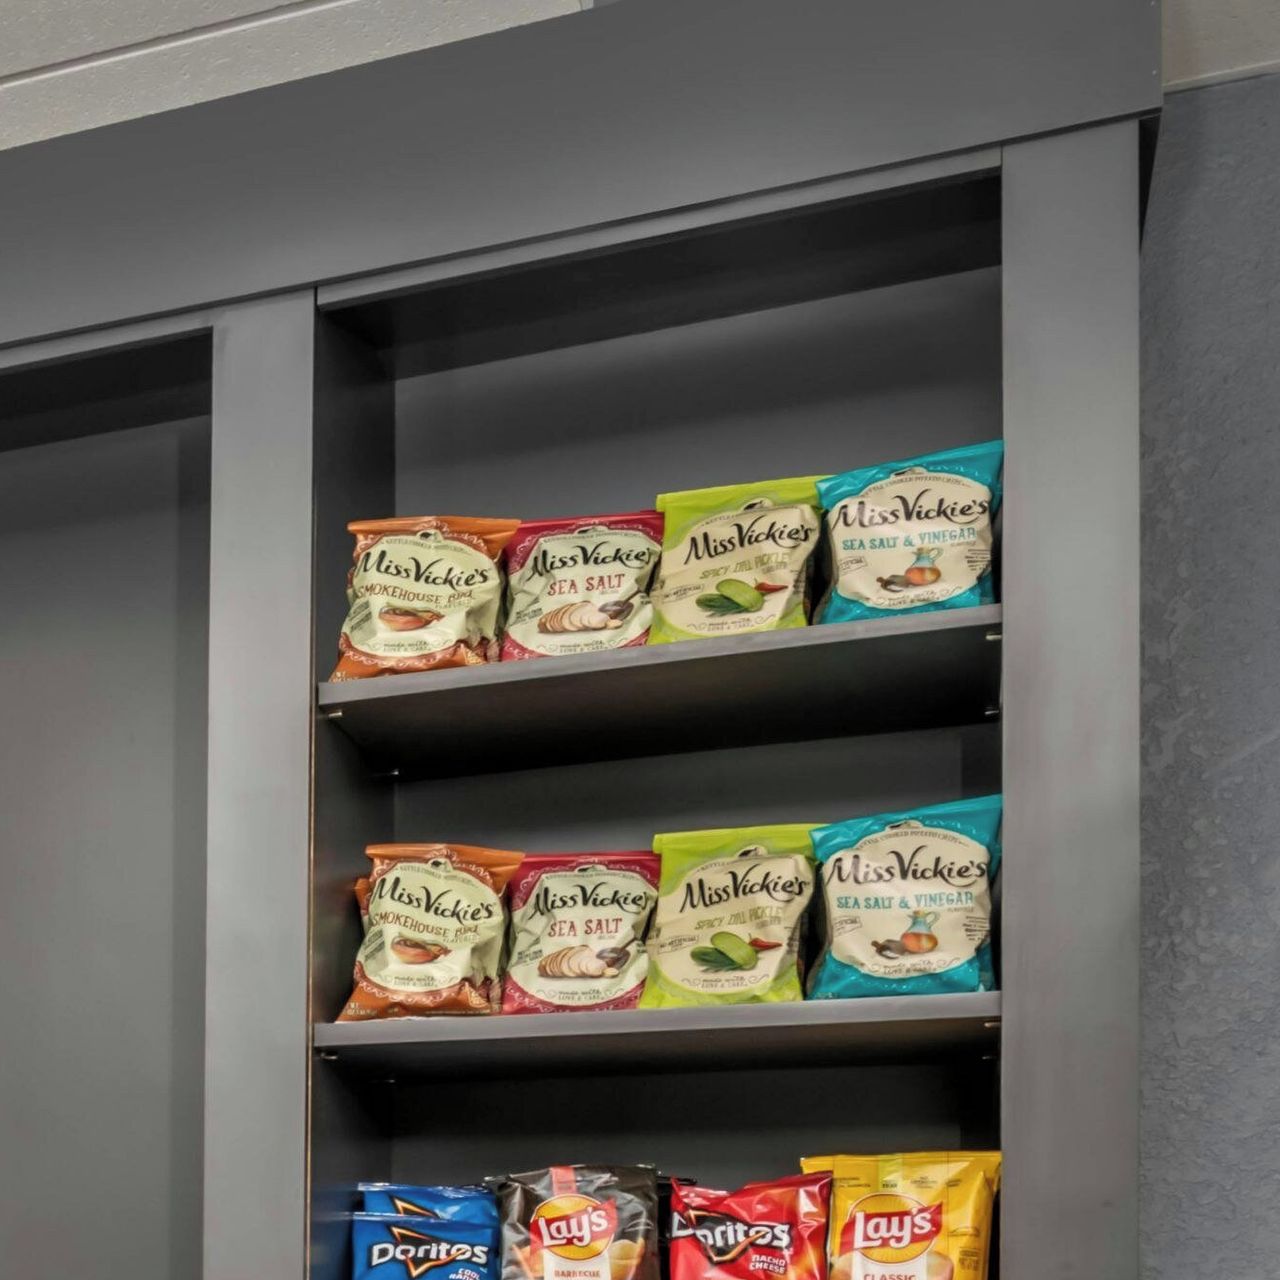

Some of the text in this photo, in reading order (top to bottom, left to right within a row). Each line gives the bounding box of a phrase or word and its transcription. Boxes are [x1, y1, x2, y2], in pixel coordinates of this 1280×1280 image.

[832, 488, 989, 531] Miss Vickie's
[683, 514, 814, 565] Miss Vickie's
[842, 527, 977, 551] SEA SALT & VINEGAR
[355, 550, 490, 591] Miss Vickie's
[526, 549, 578, 582] Miss
[356, 583, 441, 604] SMOKEHOUSE
[548, 573, 625, 597] SEA SALT
[826, 845, 987, 888] Miss Vickie's
[372, 877, 495, 923] Miss Vickie's
[528, 887, 578, 920] Miss
[679, 864, 807, 913] Miss Vickie's
[837, 891, 975, 909] SEA SALT & VINEGAR
[372, 911, 450, 938] SMOKEHOUSE
[548, 918, 623, 938] SEA SALT
[538, 1206, 610, 1247] Lay's
[671, 1211, 791, 1248] Dritos
[854, 1207, 932, 1249] Lay's
[371, 1243, 489, 1267] Doritos
[749, 1262, 786, 1275] CHEESE
[751, 1254, 786, 1267] NACHO
[458, 1268, 481, 1280] COOL
[554, 1269, 601, 1280] BARBECUE
